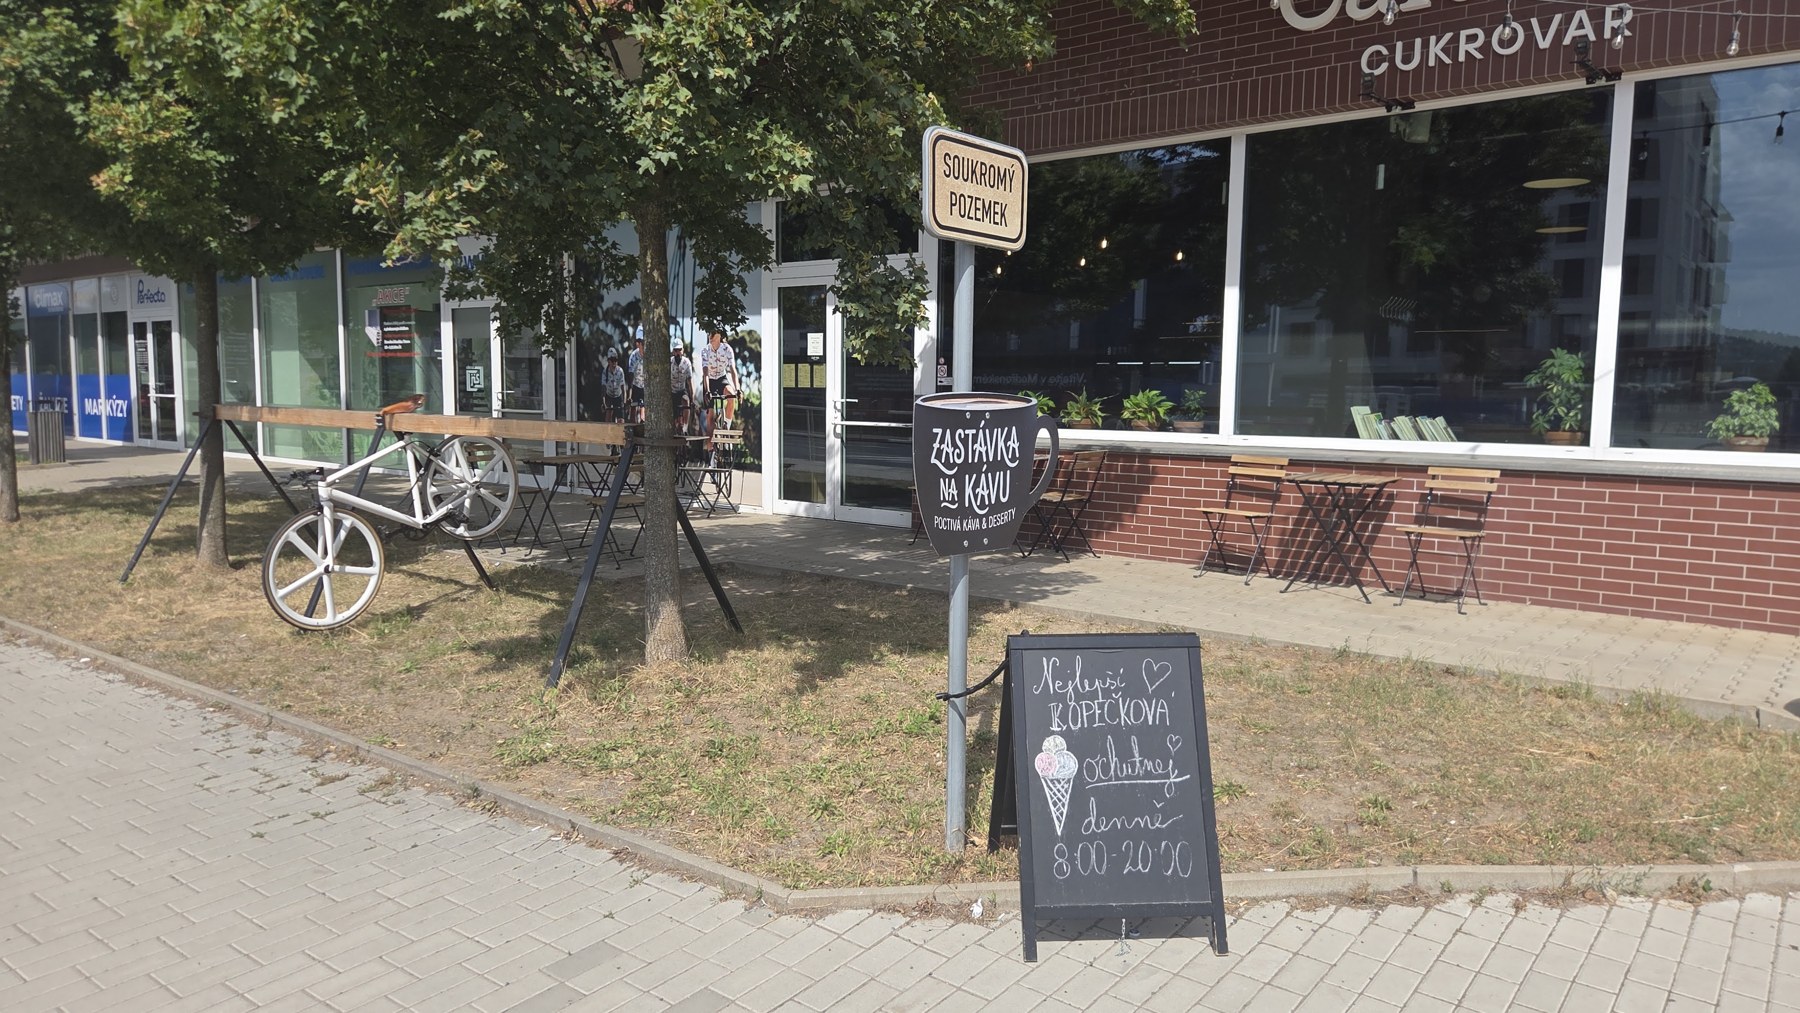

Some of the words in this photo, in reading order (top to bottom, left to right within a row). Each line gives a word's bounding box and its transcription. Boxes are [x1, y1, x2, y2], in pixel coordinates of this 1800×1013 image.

[1360, 2, 1634, 77] CUKROVAR
[943, 152, 1015, 193] SOUKROMÝ
[950, 191, 1008, 228] POZEMEK
[136, 279, 166, 305] Perfecto
[85, 394, 128, 418] MARKÝZY
[930, 420, 1020, 475] ZASTÁVKA
[940, 478, 958, 509] NA
[965, 464, 1010, 514] KÁVU
[934, 515, 961, 531] POCTIVÁ
[962, 515, 980, 531] KÁVA
[981, 517, 987, 529] &
[989, 507, 1016, 527] DESERTY
[1083, 735, 1180, 798] ochutnej
[1081, 797, 1183, 835] denně
